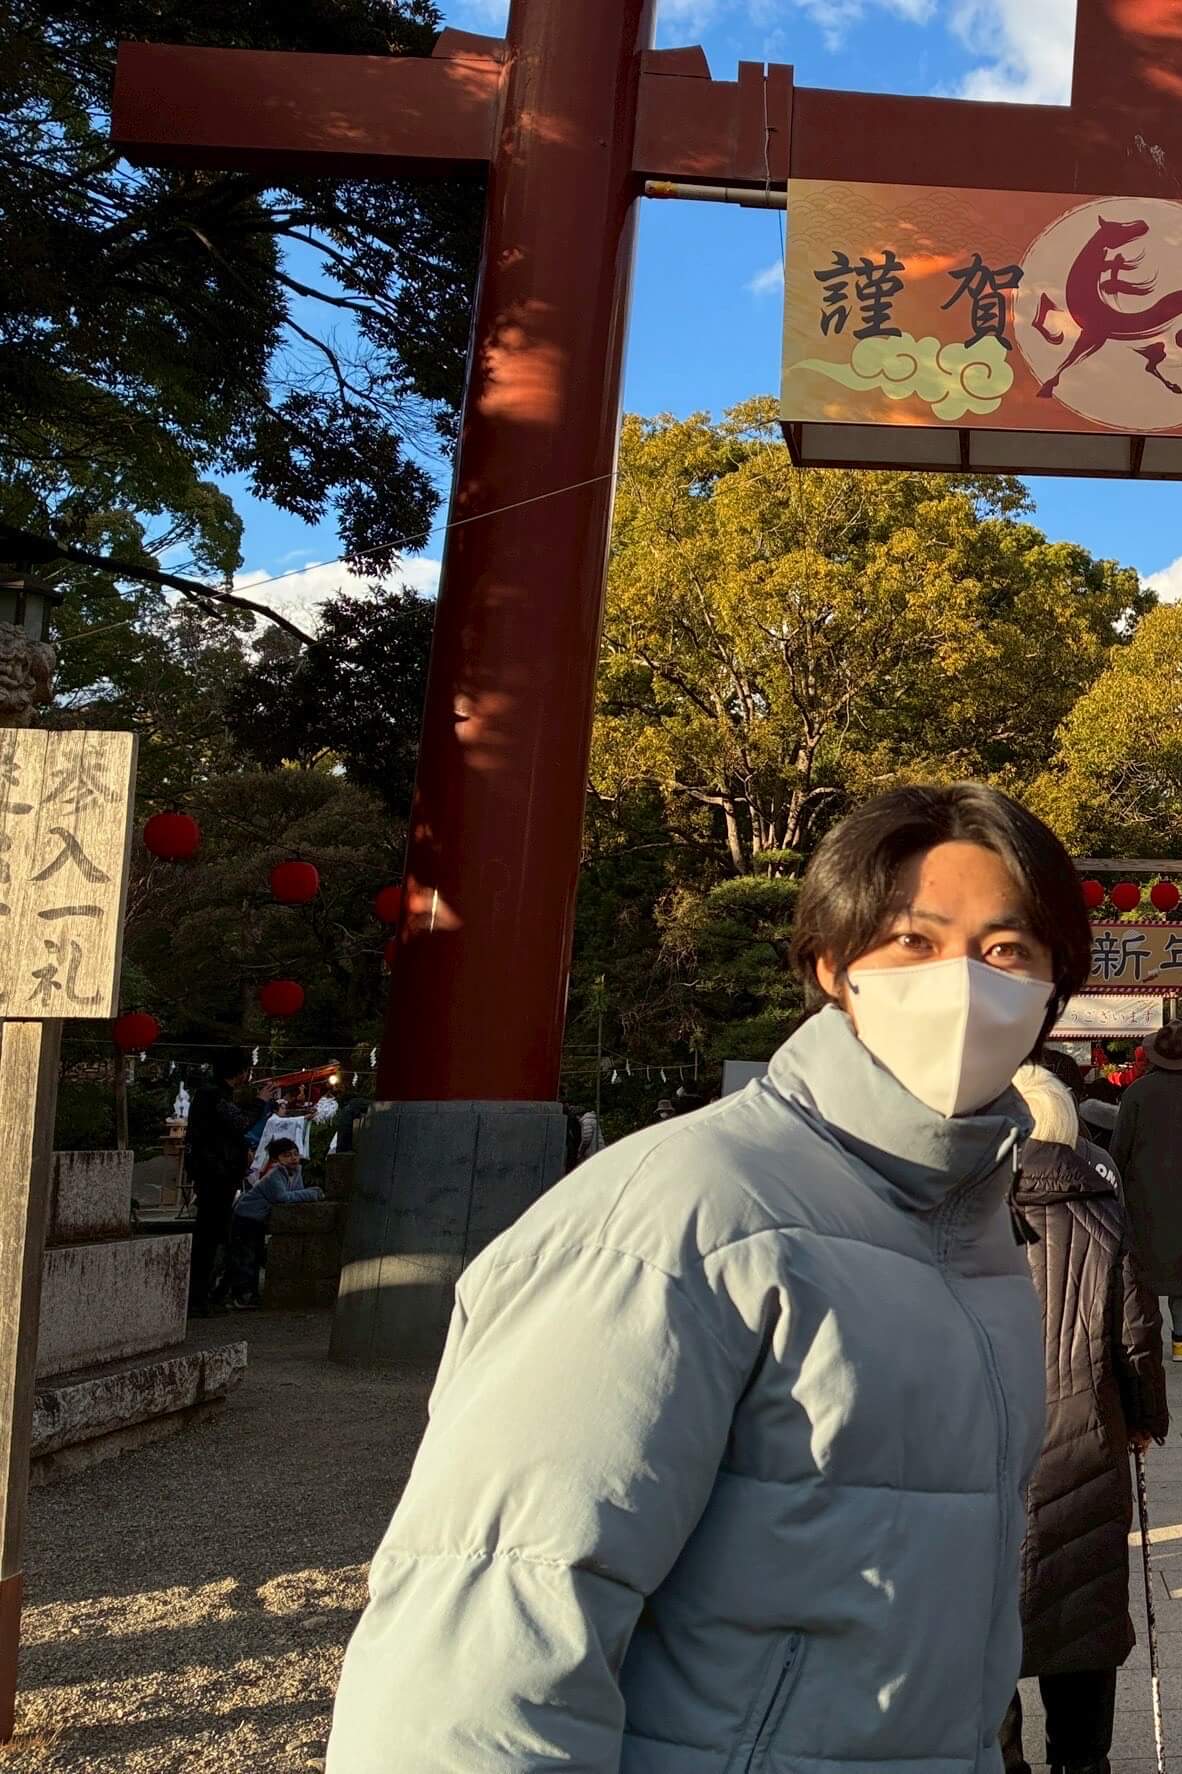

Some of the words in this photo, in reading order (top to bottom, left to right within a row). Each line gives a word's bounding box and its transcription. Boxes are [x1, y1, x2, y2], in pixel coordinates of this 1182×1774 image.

[1057, 1007, 1154, 1026] うございます
